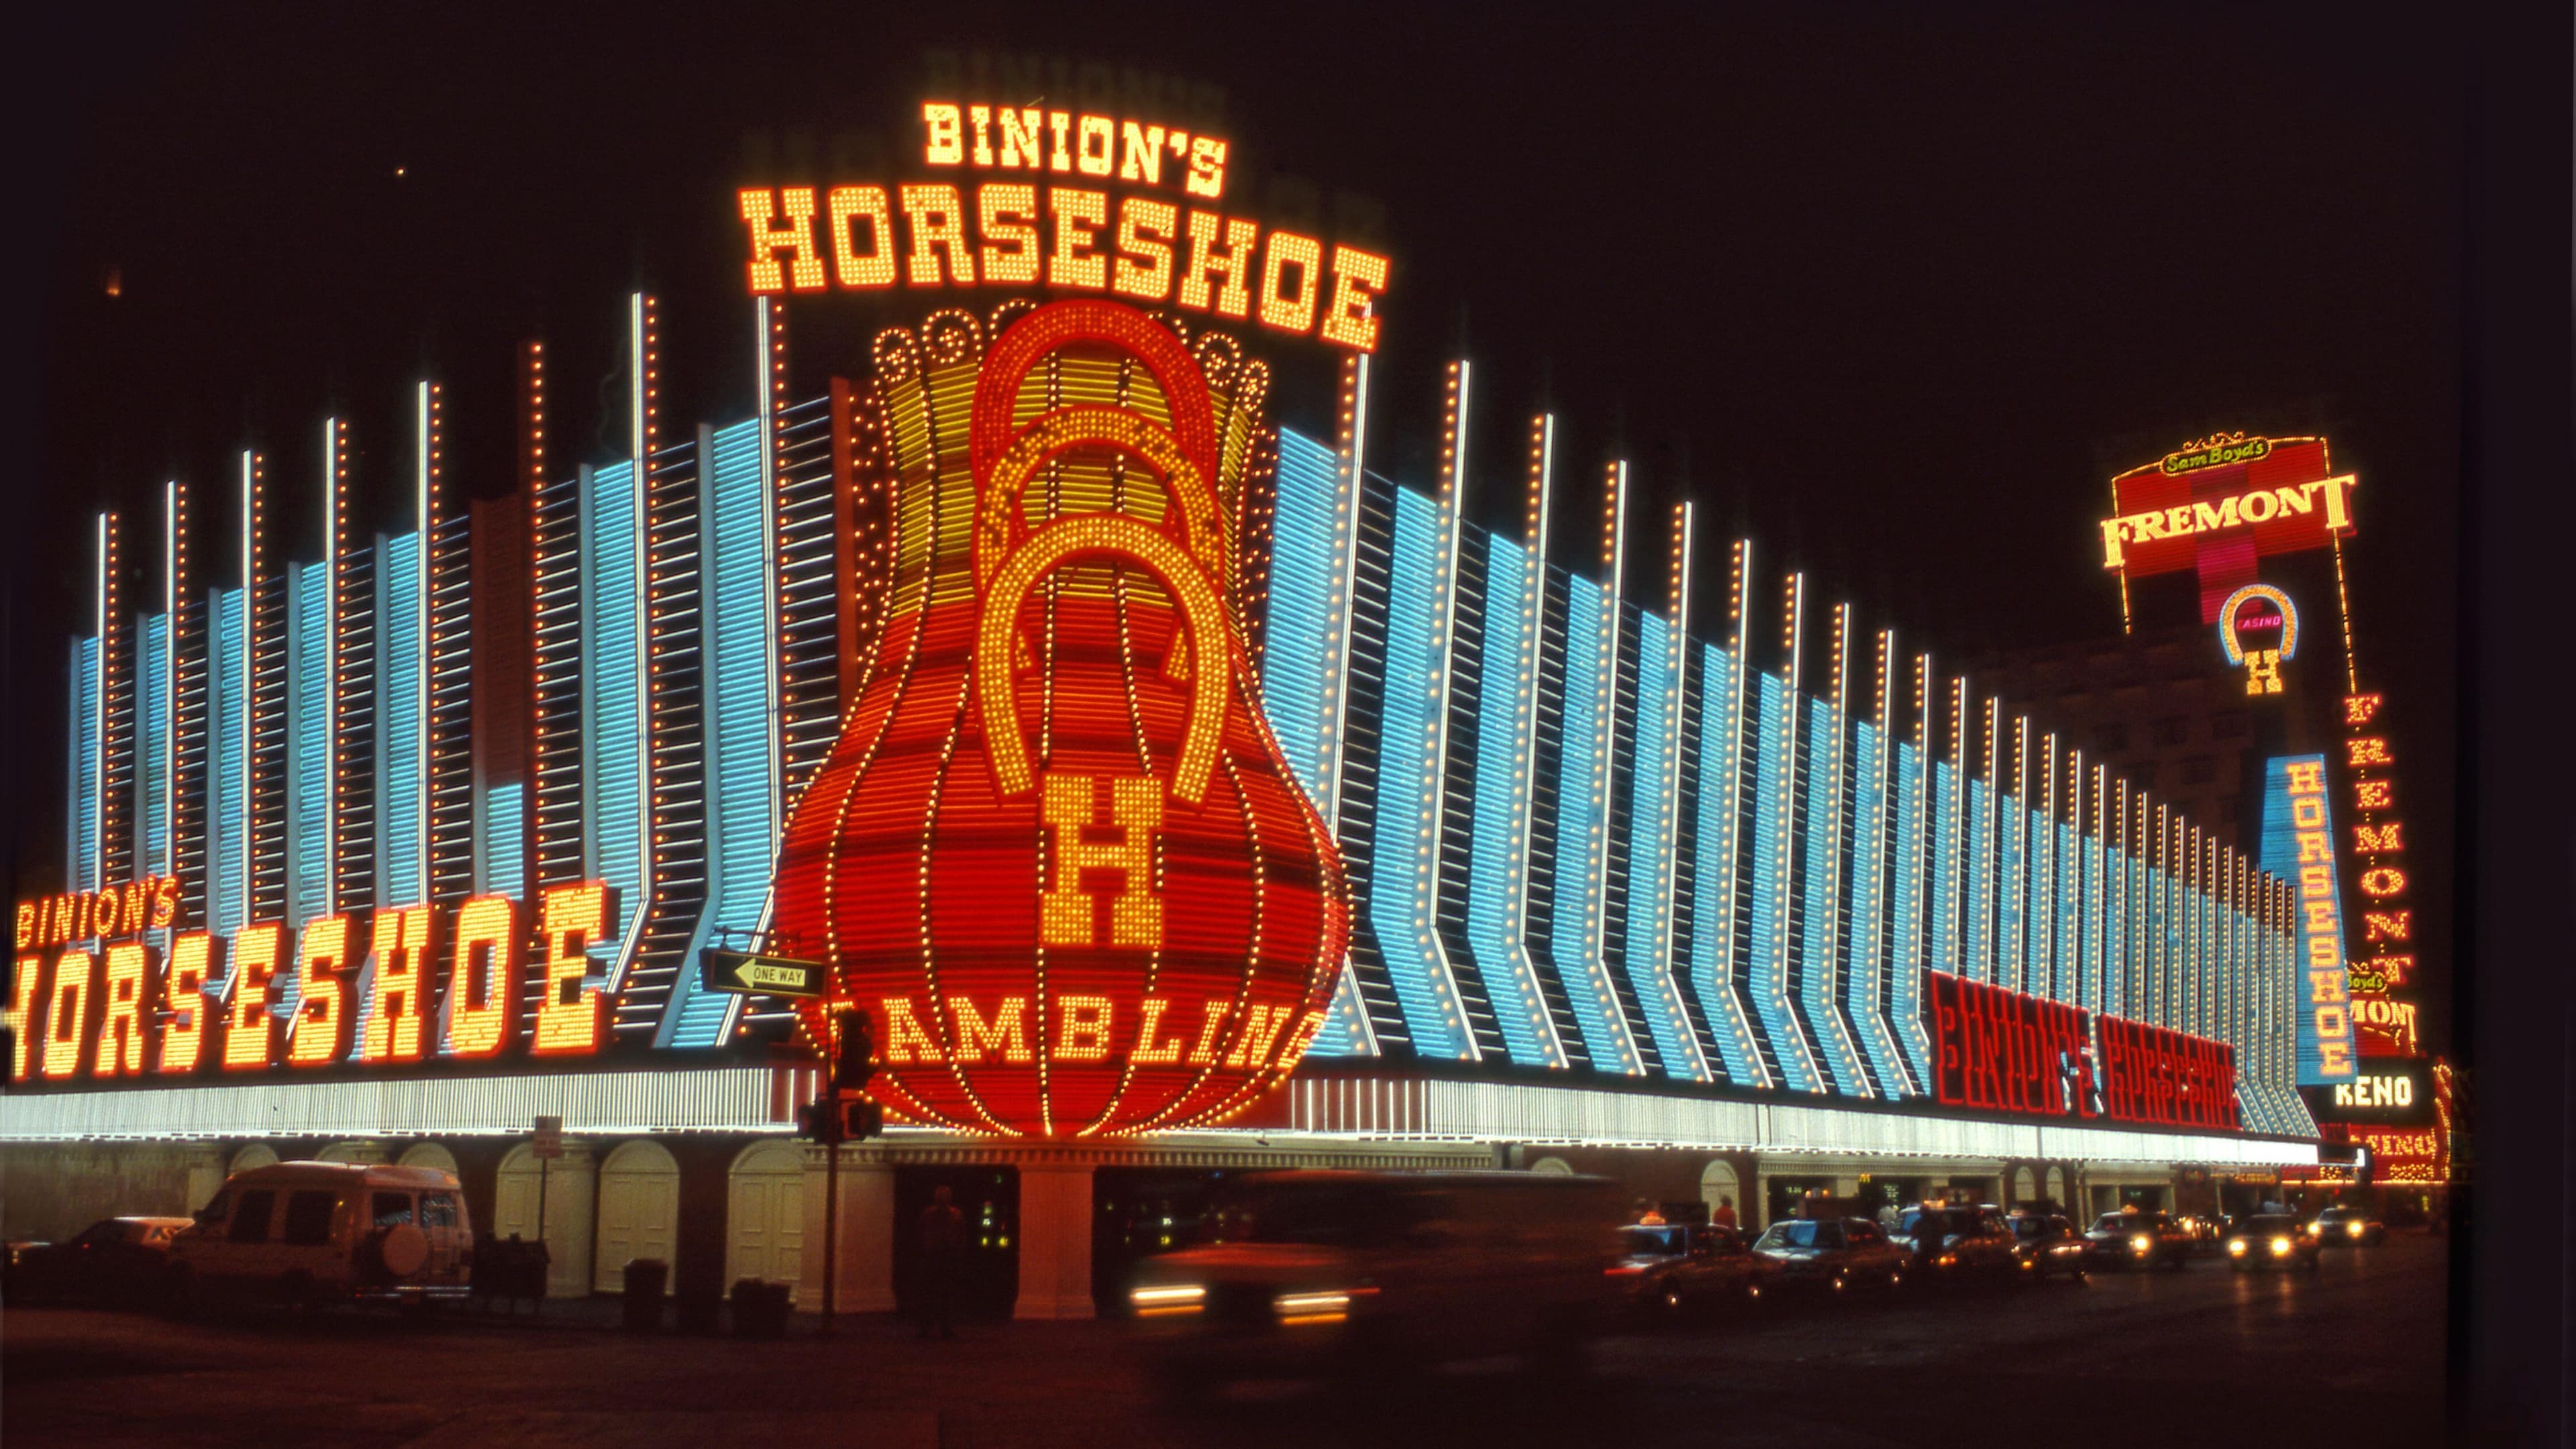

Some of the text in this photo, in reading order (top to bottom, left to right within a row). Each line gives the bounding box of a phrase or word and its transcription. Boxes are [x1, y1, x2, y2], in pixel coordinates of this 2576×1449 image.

[923, 103, 1227, 199] BINION'S
[739, 183, 1389, 351] HORSESHOE
[2166, 440, 2265, 473] Sam Boyd's
[2100, 474, 2357, 568] FREMONT
[2243, 648, 2283, 695] H
[1041, 773, 1164, 946] H
[2344, 694, 2413, 985] FREMONT
[17, 874, 178, 949] BINION'S
[2285, 761, 2353, 1076] HORSESHOE
[753, 967, 803, 983] ONE WAY
[823, 996, 1327, 1071] AMBLING
[2335, 1075, 2413, 1106] KENO
